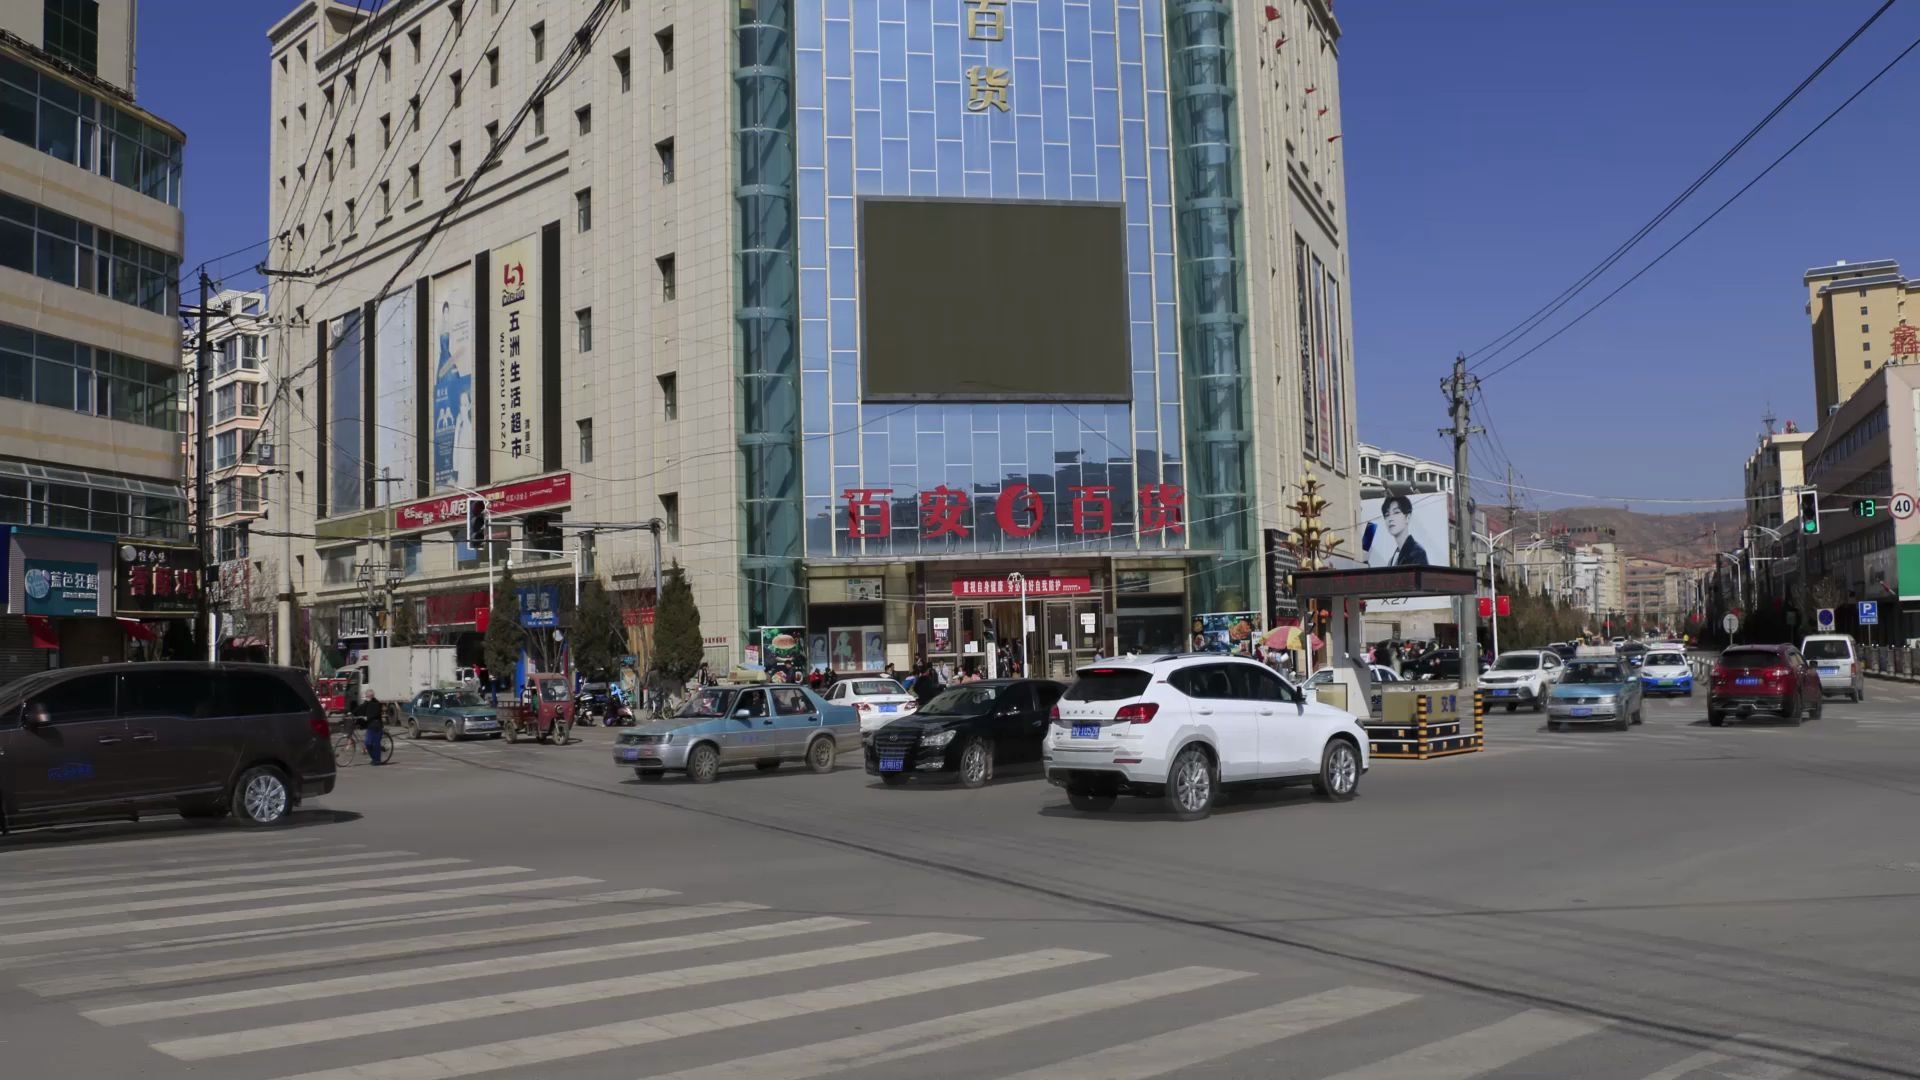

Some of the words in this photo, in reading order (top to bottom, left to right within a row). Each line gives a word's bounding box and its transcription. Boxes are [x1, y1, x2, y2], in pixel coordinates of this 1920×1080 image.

[1859, 500, 1875, 517] 13
[1894, 500, 1911, 513] 40
[1863, 603, 1873, 614] P
